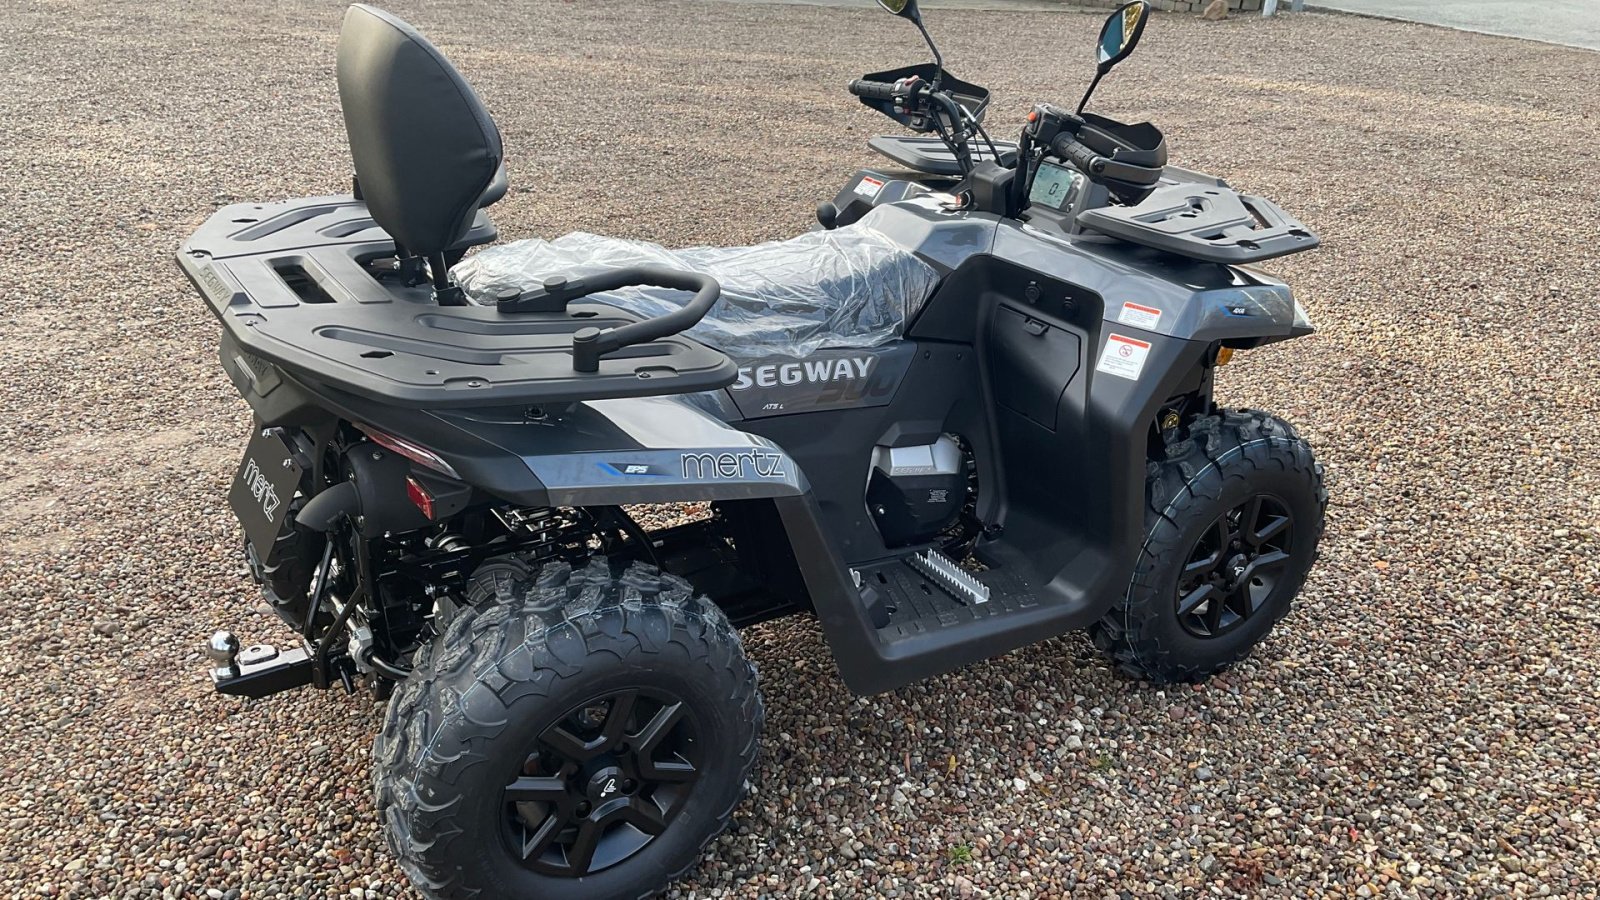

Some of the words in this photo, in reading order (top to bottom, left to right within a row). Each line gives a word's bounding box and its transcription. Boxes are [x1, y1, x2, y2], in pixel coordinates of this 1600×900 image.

[1048, 182, 1060, 196] 0
[199, 266, 231, 302] SEGWAY
[731, 356, 875, 391] SEGWAY
[624, 465, 649, 474] EPS
[681, 449, 785, 479] mertz
[243, 457, 281, 523] mertz
